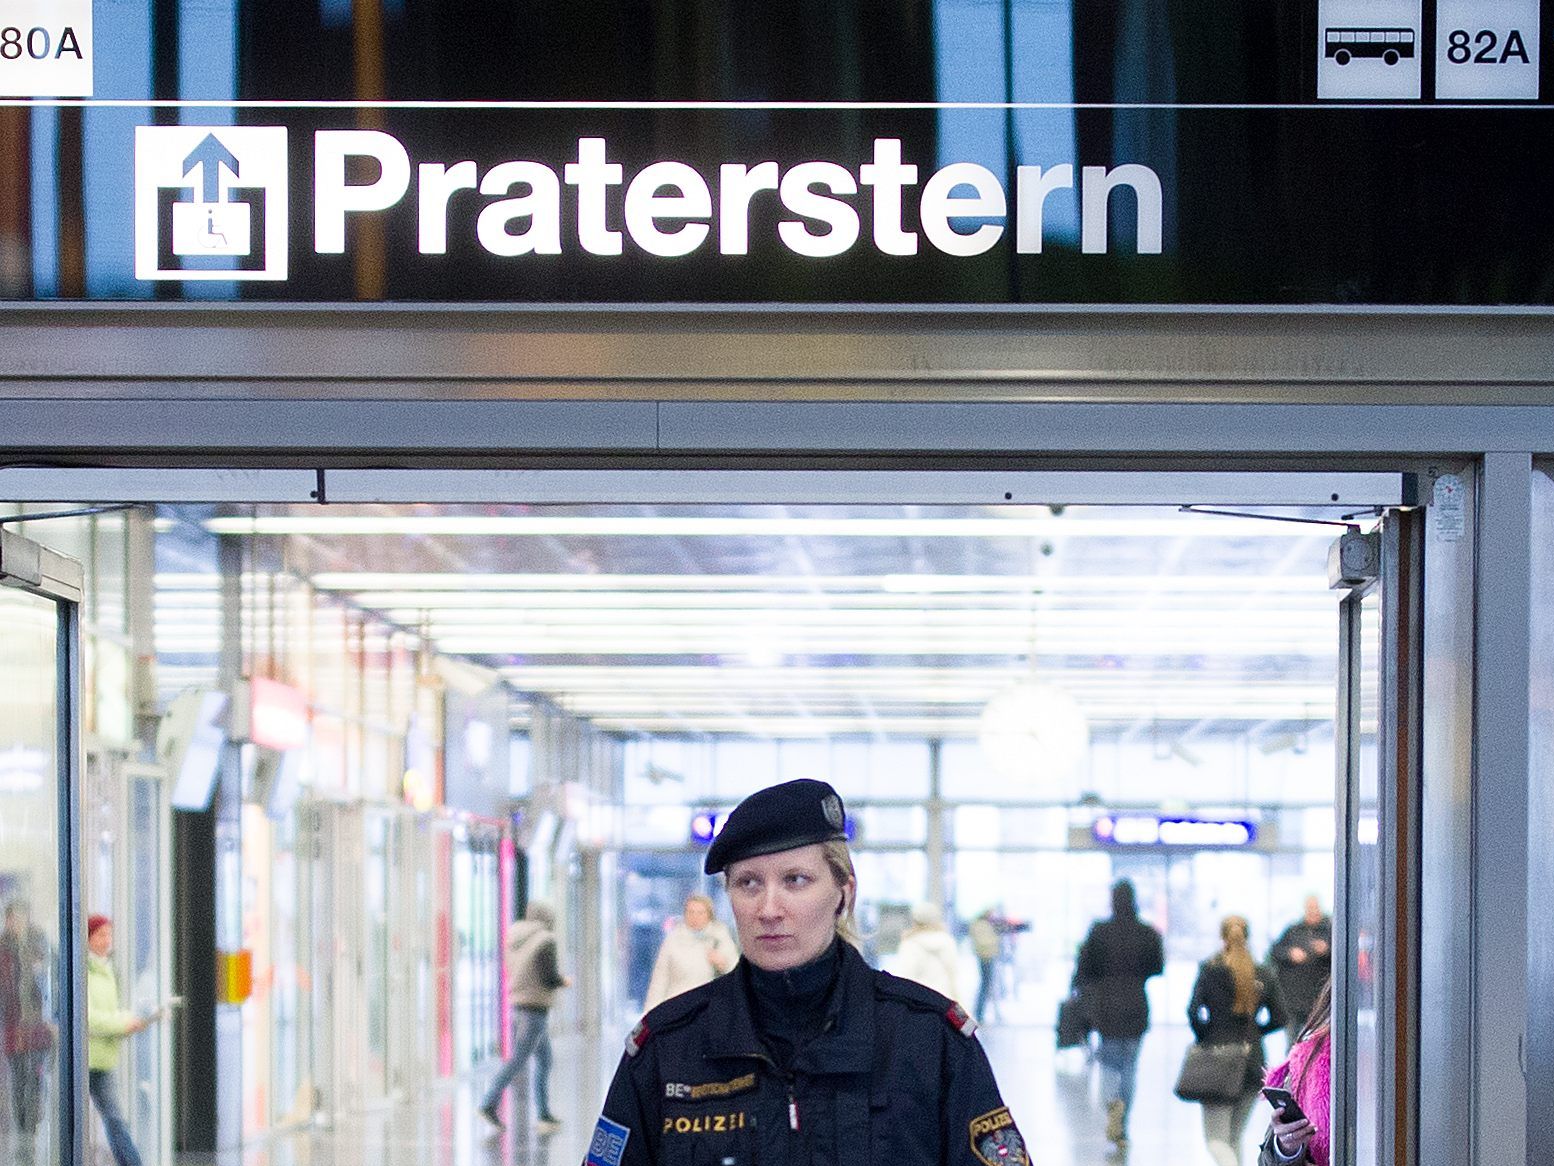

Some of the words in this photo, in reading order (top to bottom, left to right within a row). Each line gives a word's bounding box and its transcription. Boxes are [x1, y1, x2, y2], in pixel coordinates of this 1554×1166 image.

[0, 26, 83, 61] 80A
[1447, 29, 1530, 65] 82A
[314, 130, 1163, 258] Praterstern
[663, 1112, 746, 1135] POLIZEI
